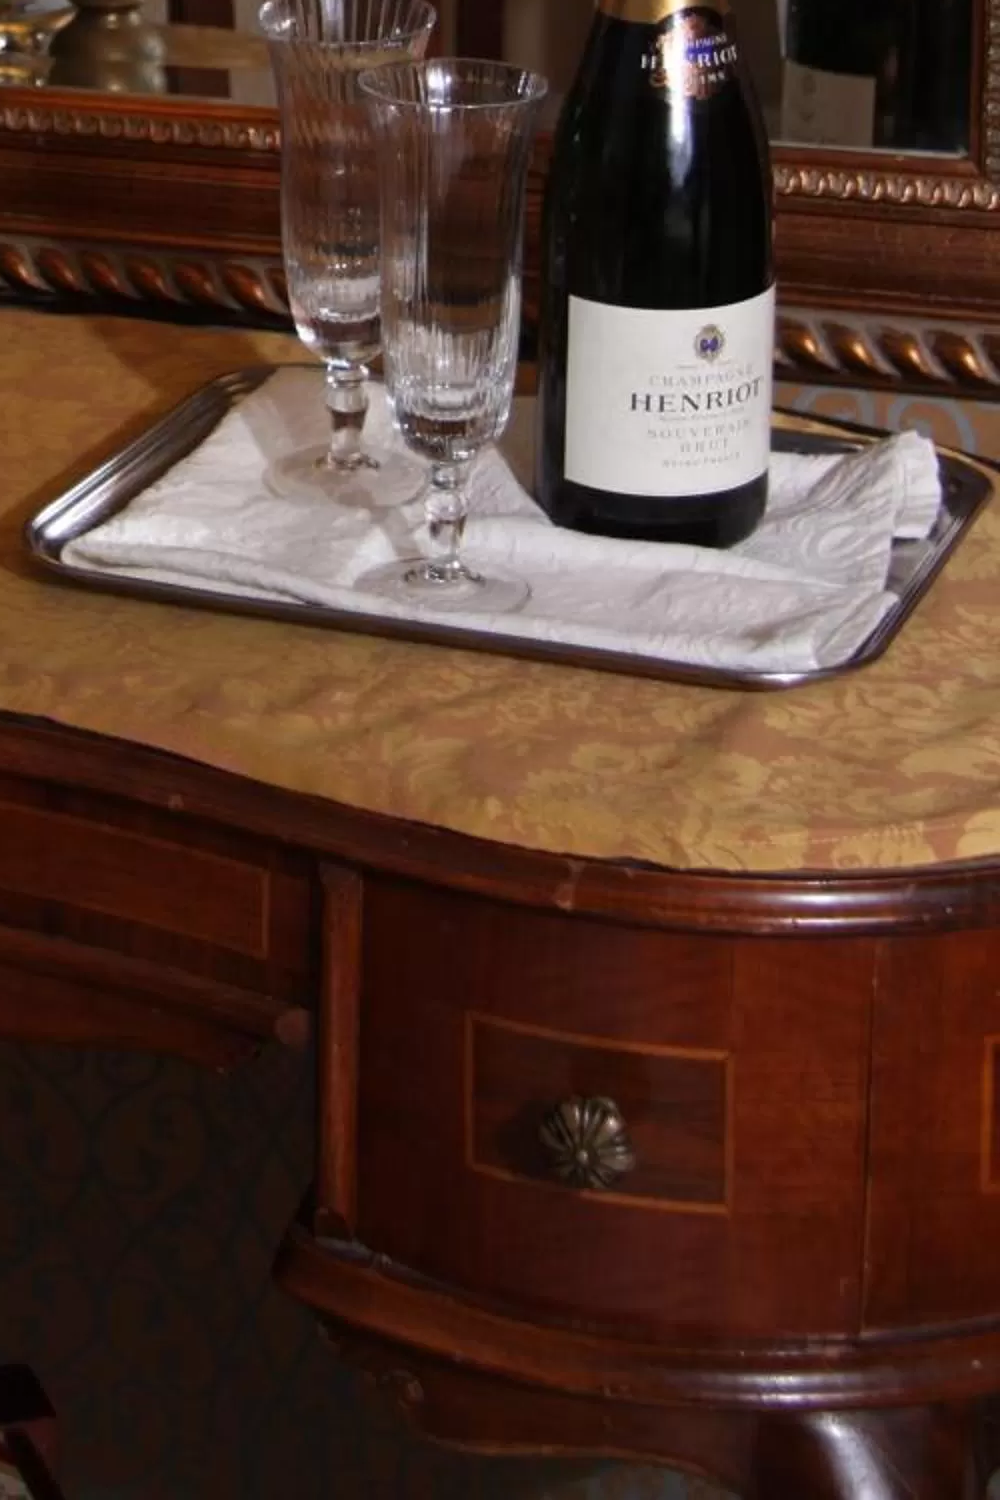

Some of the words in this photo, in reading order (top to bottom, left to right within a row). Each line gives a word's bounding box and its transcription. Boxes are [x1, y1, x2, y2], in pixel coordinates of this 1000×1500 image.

[641, 44, 738, 72] HRIOT
[649, 364, 754, 388] CHAMPAGNE
[630, 375, 764, 413] HENRIOT
